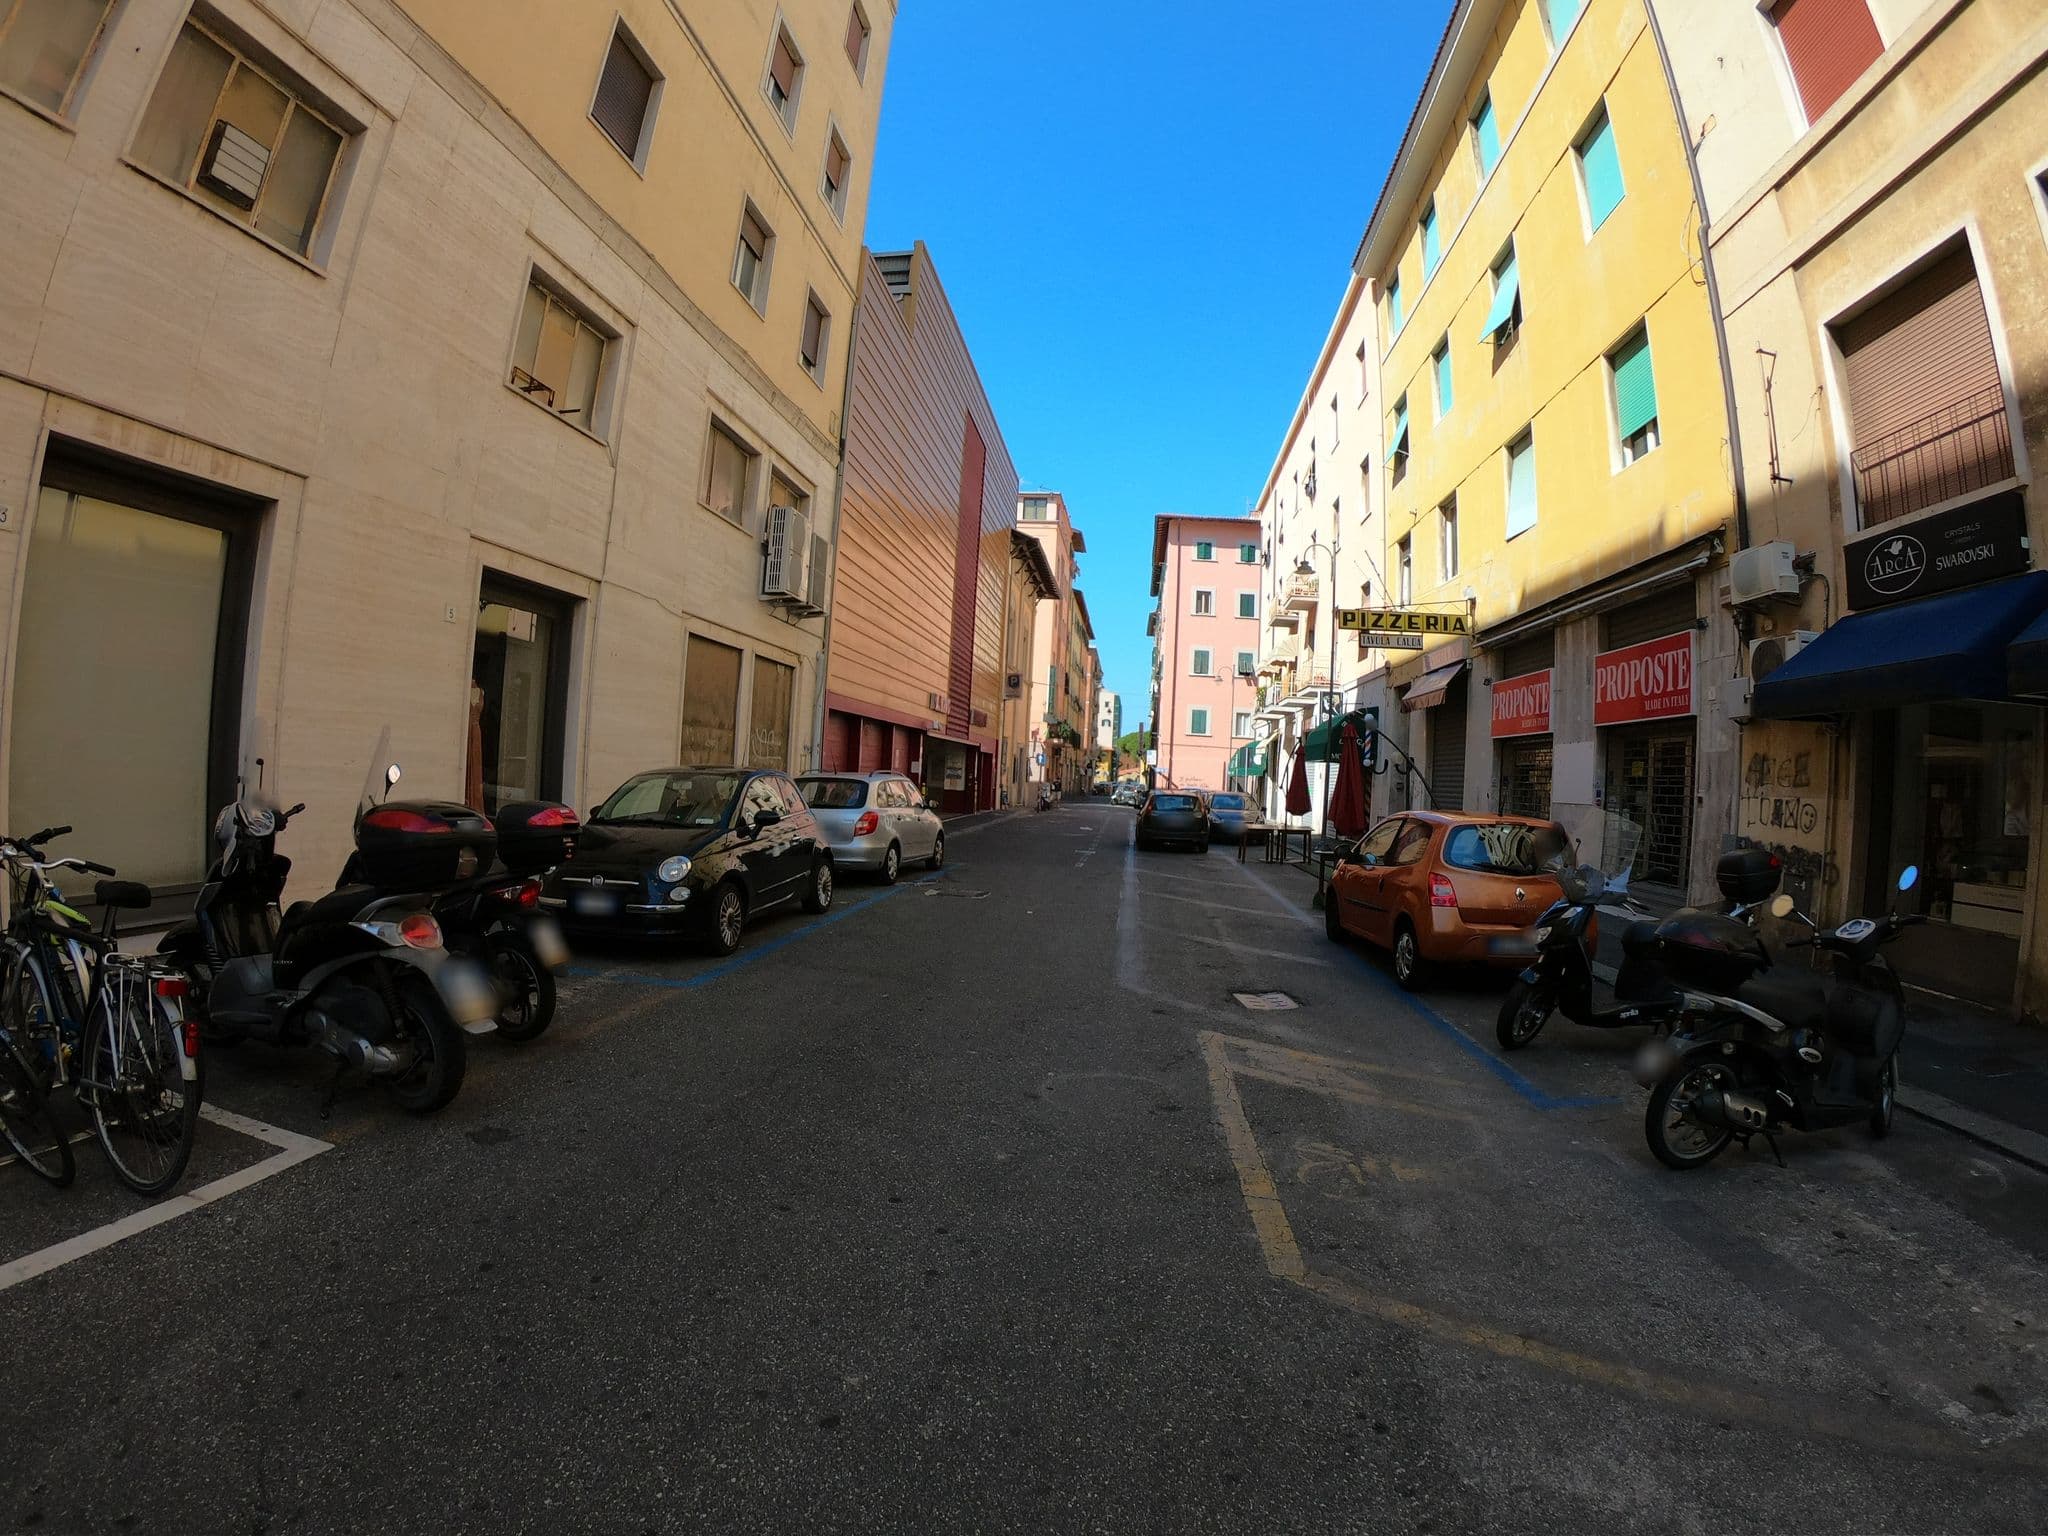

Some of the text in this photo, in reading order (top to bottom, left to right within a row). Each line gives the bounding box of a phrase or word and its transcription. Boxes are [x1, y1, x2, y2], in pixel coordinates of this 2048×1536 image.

[1944, 522, 1981, 539] CRYSTALS
[1870, 546, 1920, 578] ARCA
[1935, 543, 1995, 571] SWAROVSKI
[449, 608, 454, 619] 5
[1342, 611, 1466, 632] PIZZERIA
[1362, 635, 1421, 647] TAVOLA CALDA
[1596, 648, 1689, 703] PROPOSTE
[1492, 682, 1549, 720] PROPOSTE
[1644, 694, 1689, 710] MADE IN ITALY
